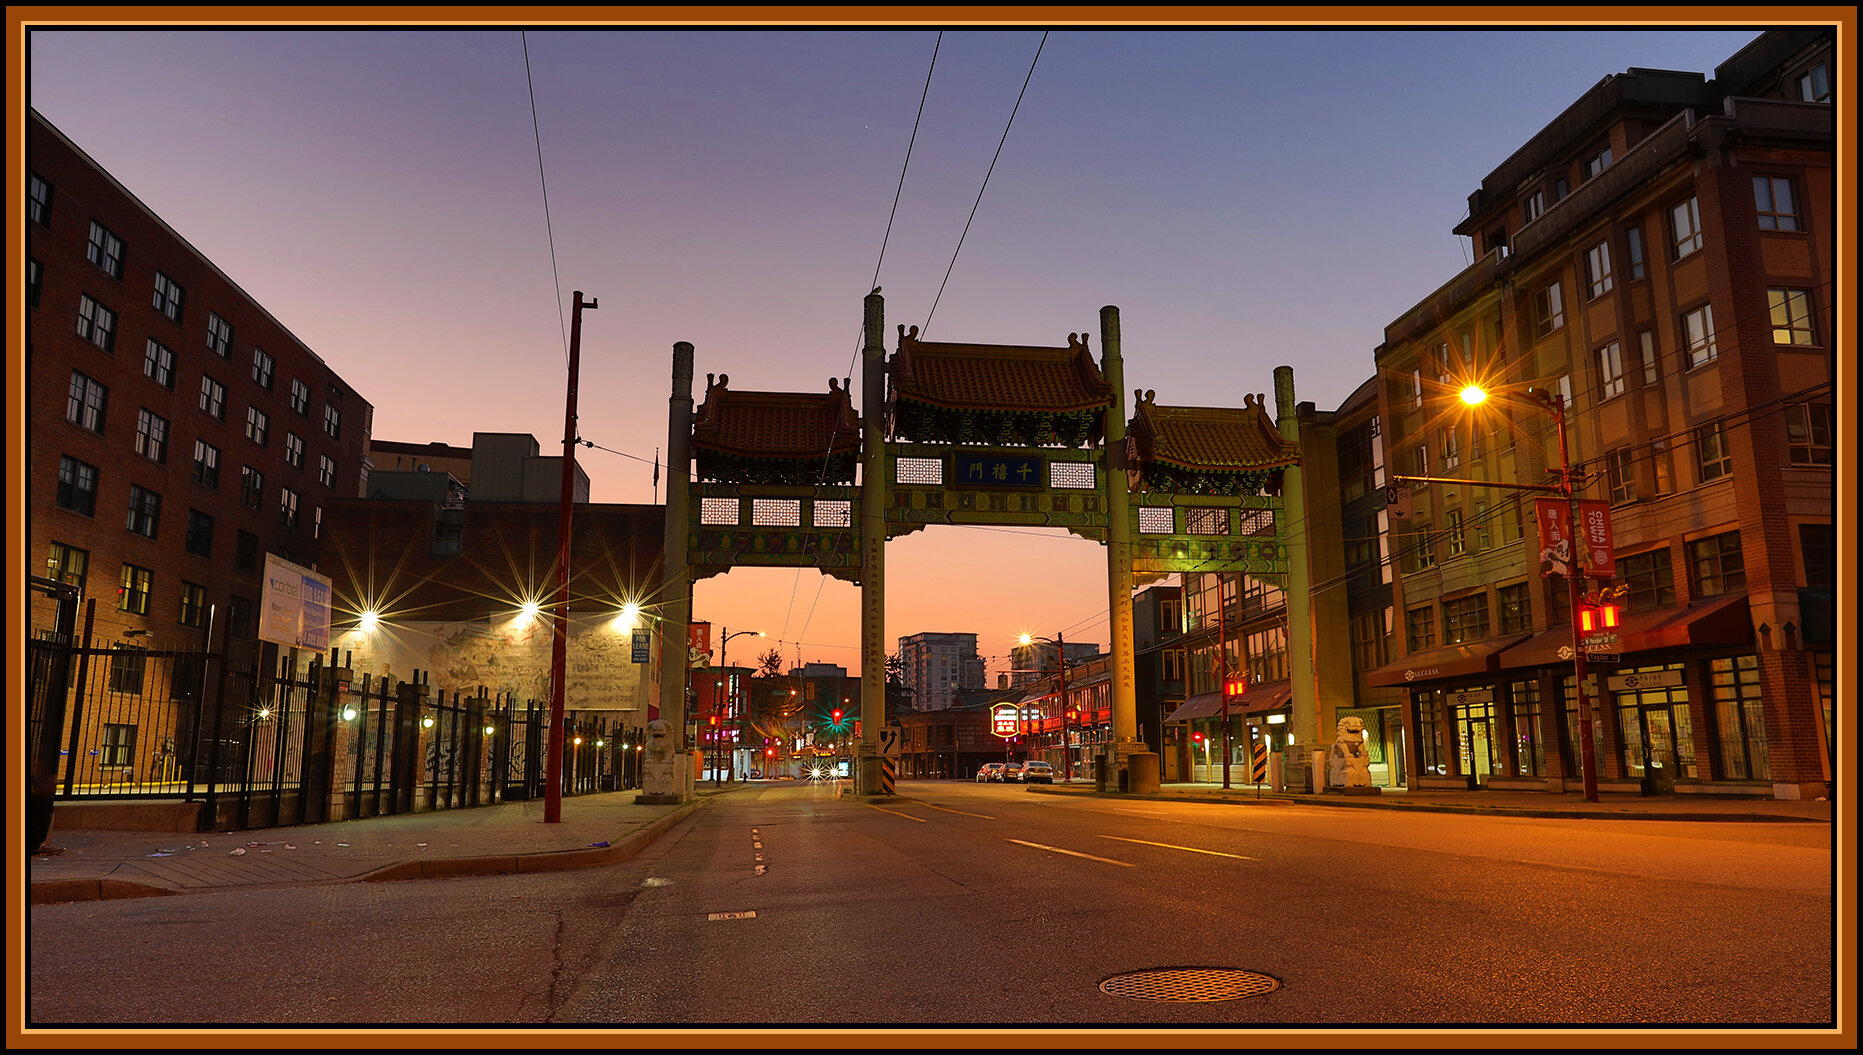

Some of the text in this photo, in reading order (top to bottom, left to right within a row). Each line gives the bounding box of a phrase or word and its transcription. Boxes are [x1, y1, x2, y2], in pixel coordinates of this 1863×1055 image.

[968, 462, 1033, 481] 千禧門
[1547, 509, 1561, 541] 唐人街
[1587, 510, 1599, 543] TOWN
[1595, 511, 1607, 544] CHINA
[1590, 654, 1609, 662] Taylor
